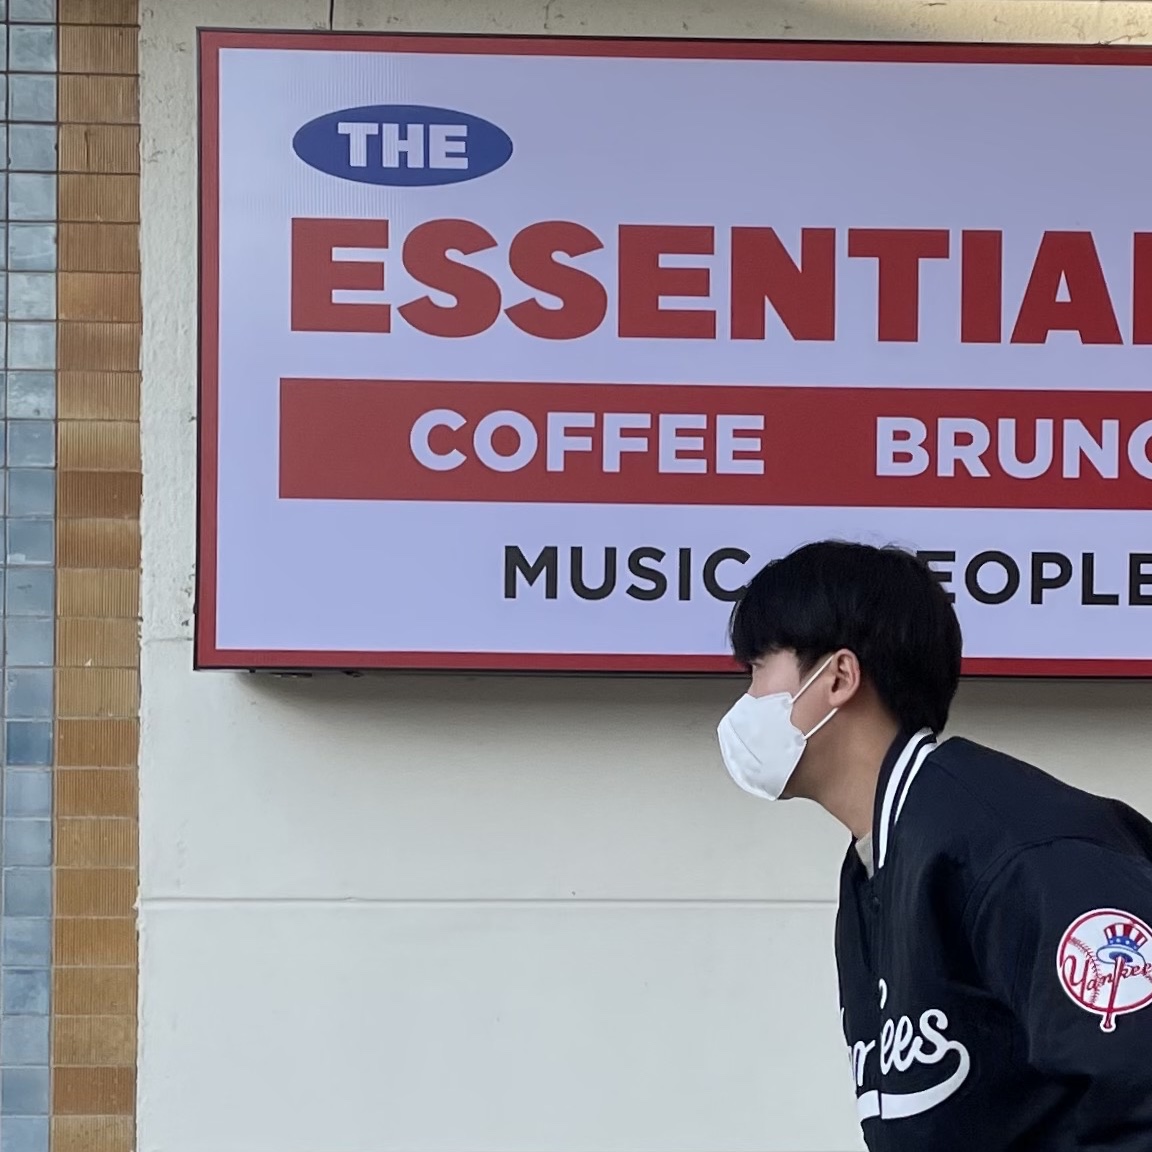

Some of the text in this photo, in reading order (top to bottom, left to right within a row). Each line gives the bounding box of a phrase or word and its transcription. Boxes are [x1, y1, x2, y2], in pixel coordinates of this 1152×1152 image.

[337, 121, 469, 171] THE
[409, 408, 765, 475] COFFEE
[504, 545, 751, 603] MUSIC
